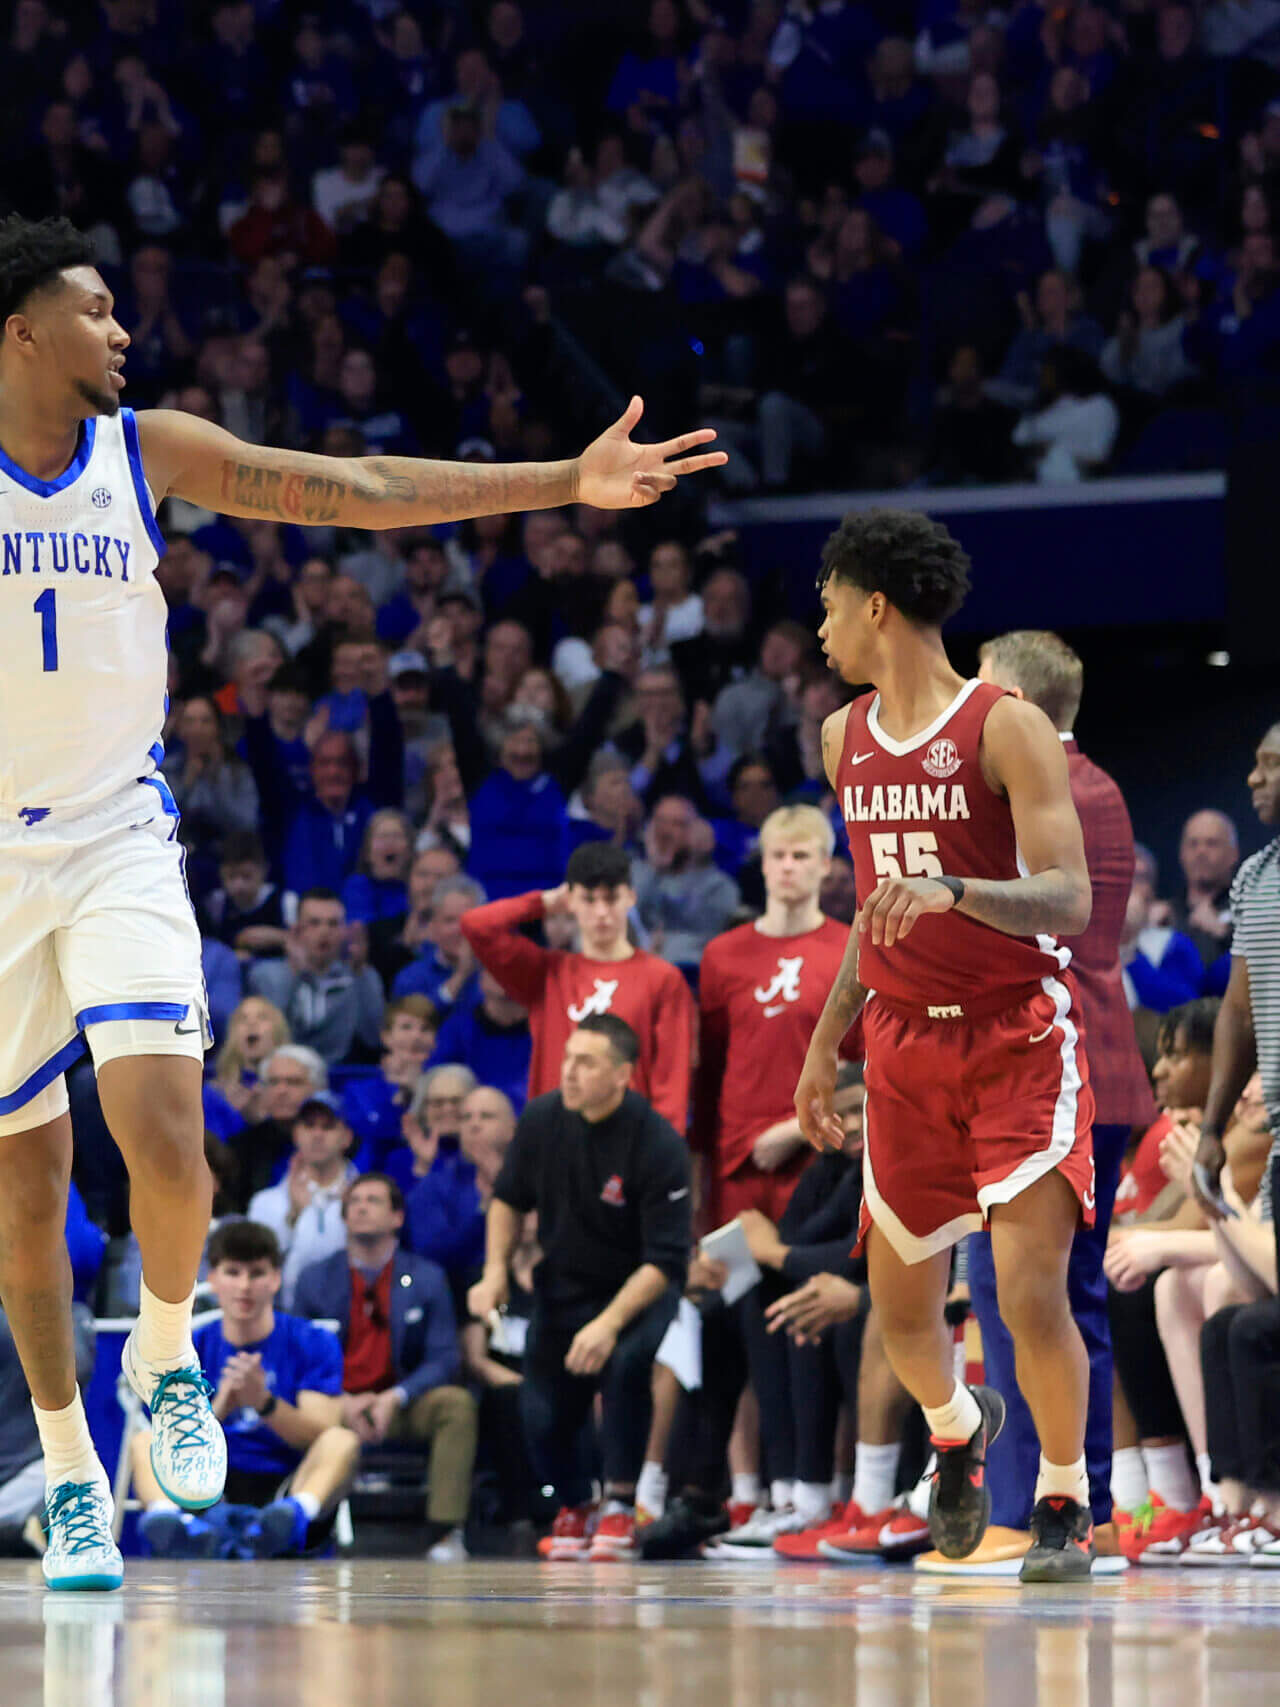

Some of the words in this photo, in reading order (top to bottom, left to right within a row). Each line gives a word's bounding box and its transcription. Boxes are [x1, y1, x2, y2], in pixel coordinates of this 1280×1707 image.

[91, 488, 112, 508] SEC
[33, 588, 58, 672] 1
[930, 741, 955, 769] SEC
[843, 784, 970, 822] ALABAMA
[869, 831, 944, 882] 55
